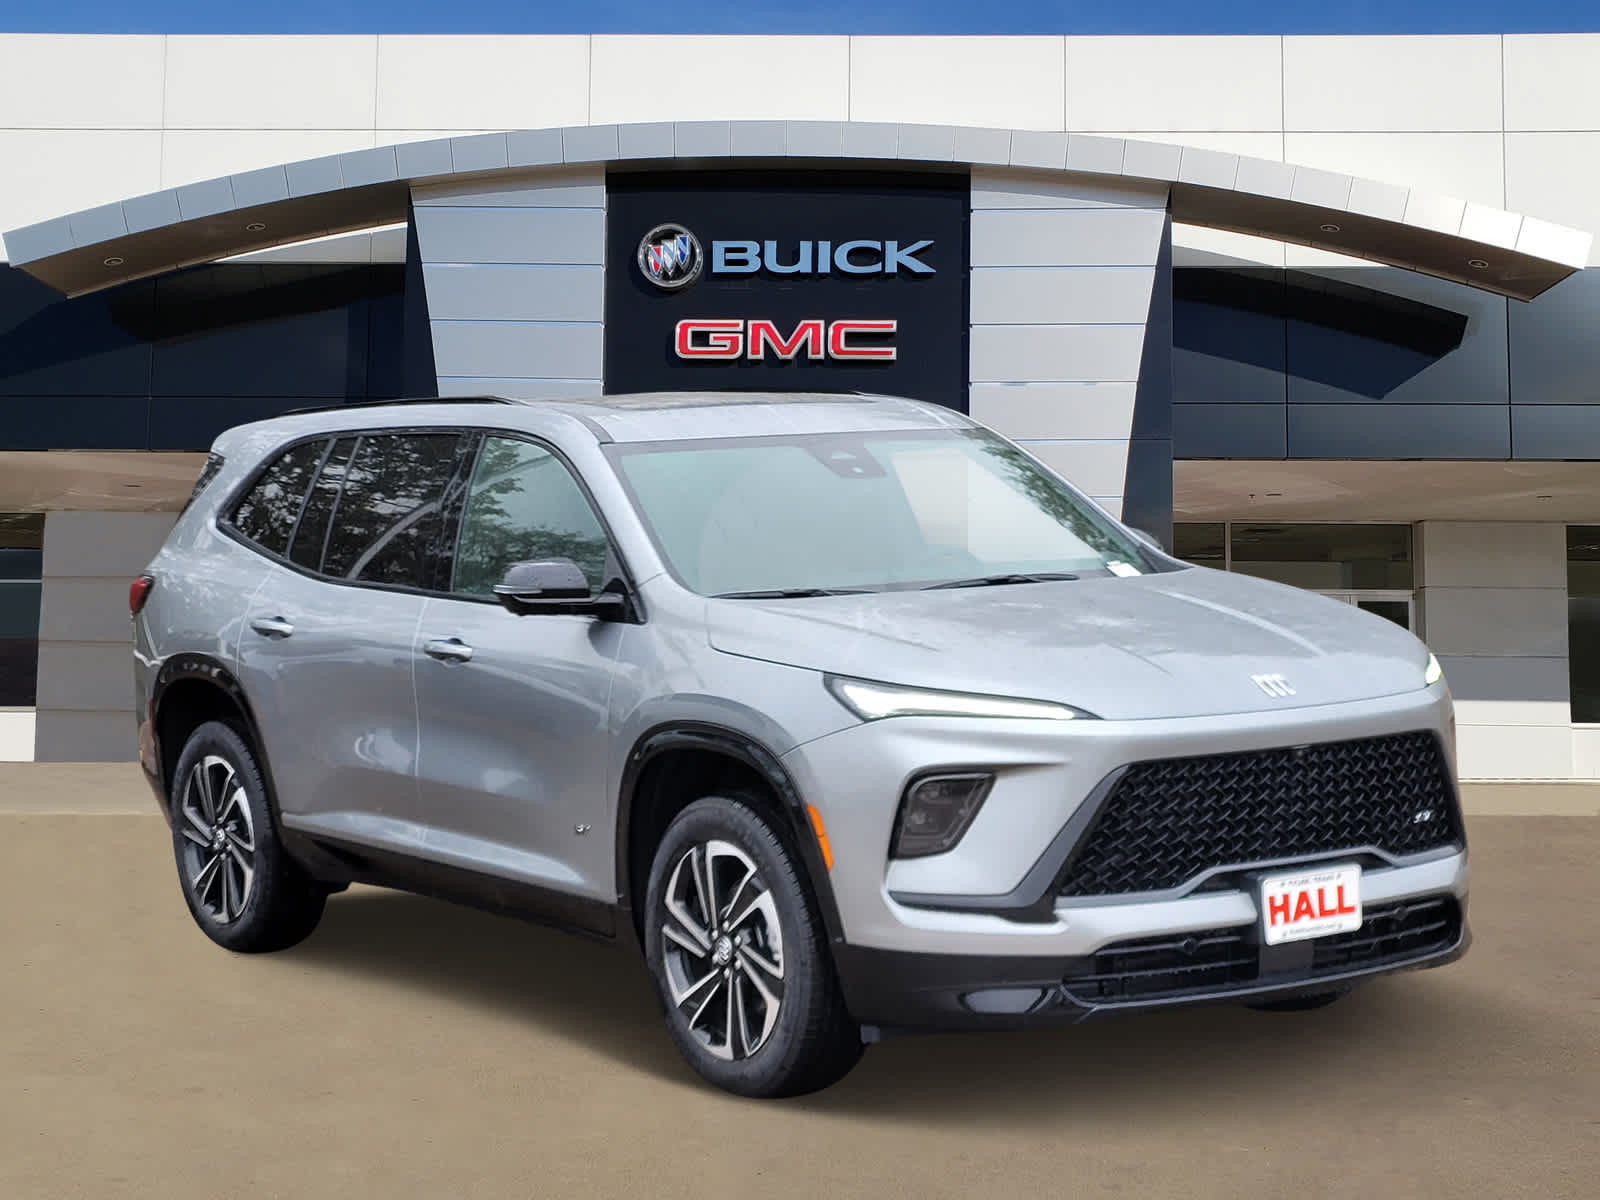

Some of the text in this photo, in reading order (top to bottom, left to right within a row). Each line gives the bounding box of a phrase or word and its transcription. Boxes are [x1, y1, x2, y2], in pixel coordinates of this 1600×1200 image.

[712, 240, 936, 273] BUICK
[674, 319, 897, 360] GMC
[1269, 885, 1355, 926] HALL
